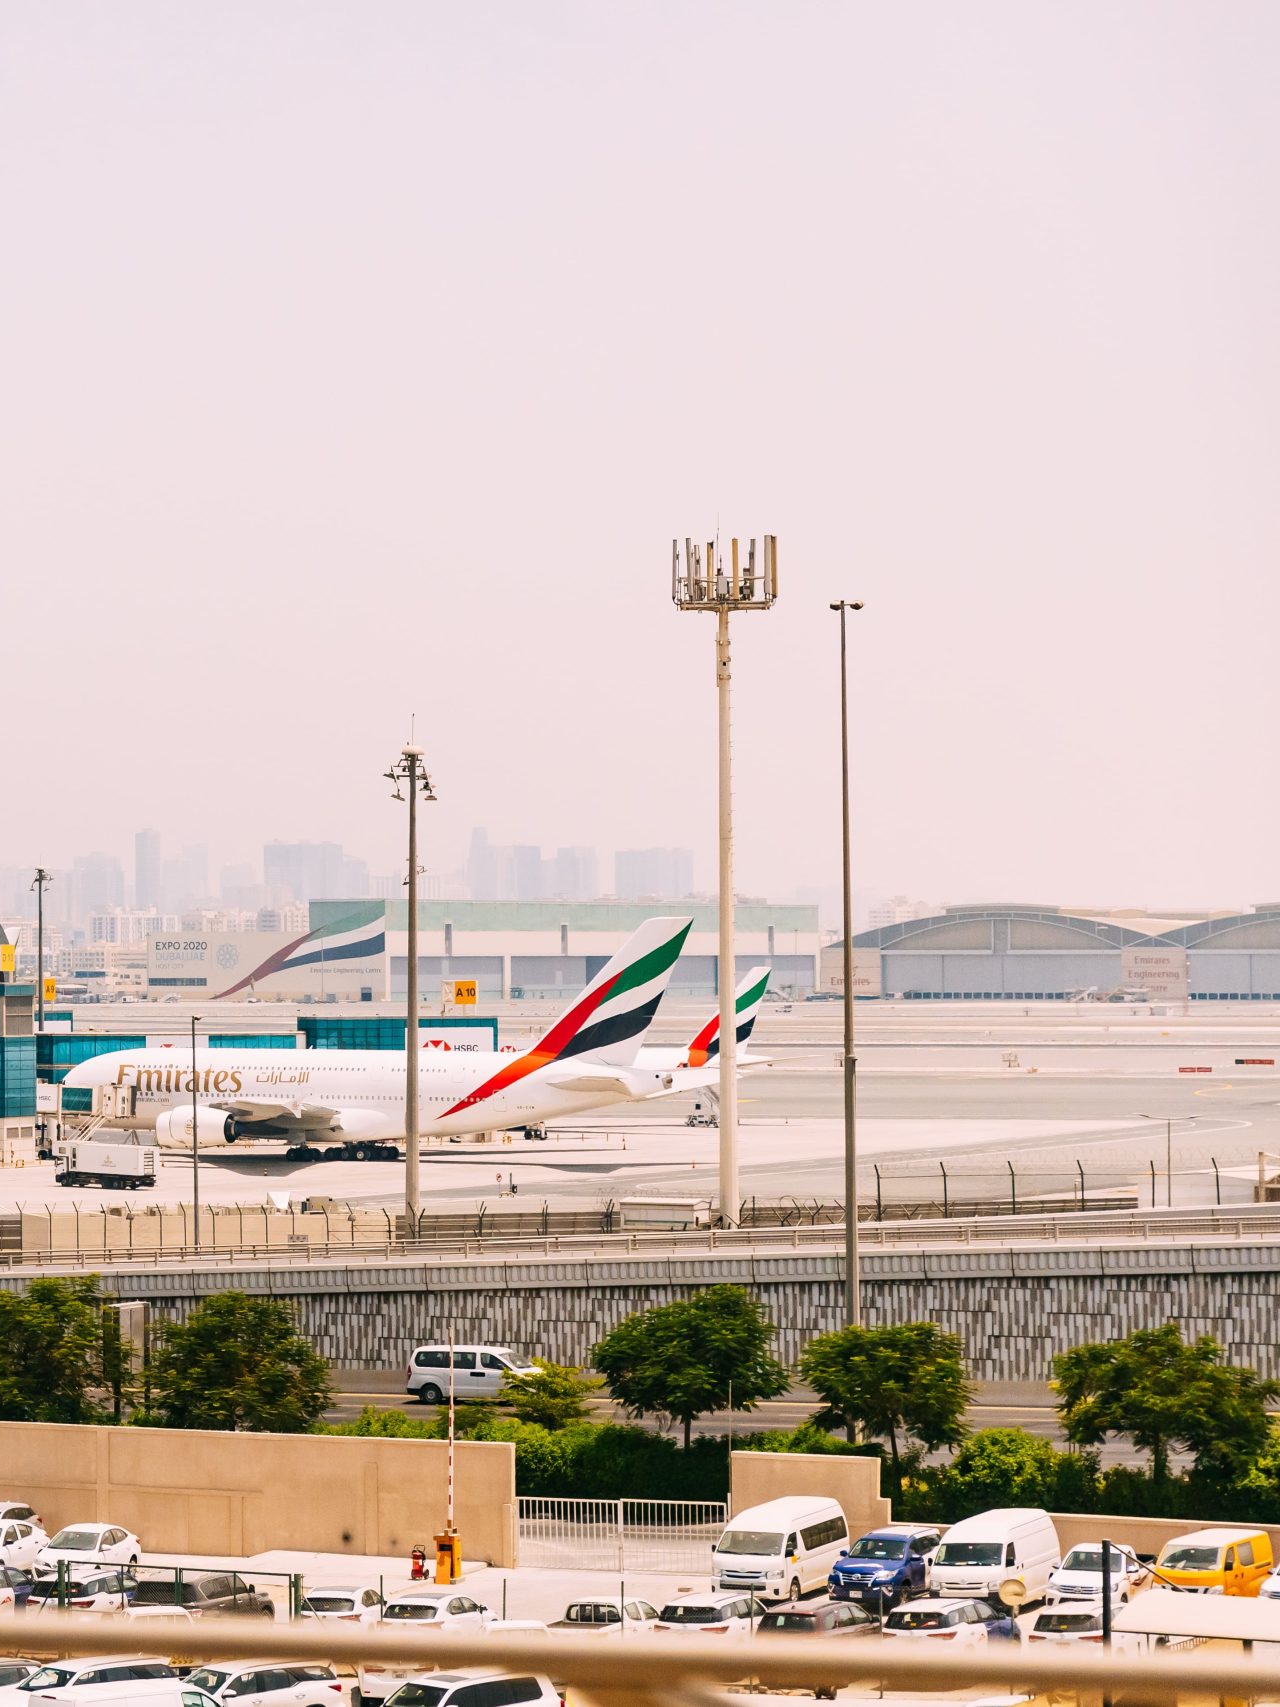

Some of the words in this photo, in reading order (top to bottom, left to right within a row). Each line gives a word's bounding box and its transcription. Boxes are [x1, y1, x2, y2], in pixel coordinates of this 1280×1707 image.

[155, 941, 181, 951] EXPO
[183, 941, 208, 951] 2020
[454, 1044, 479, 1052] HSBC
